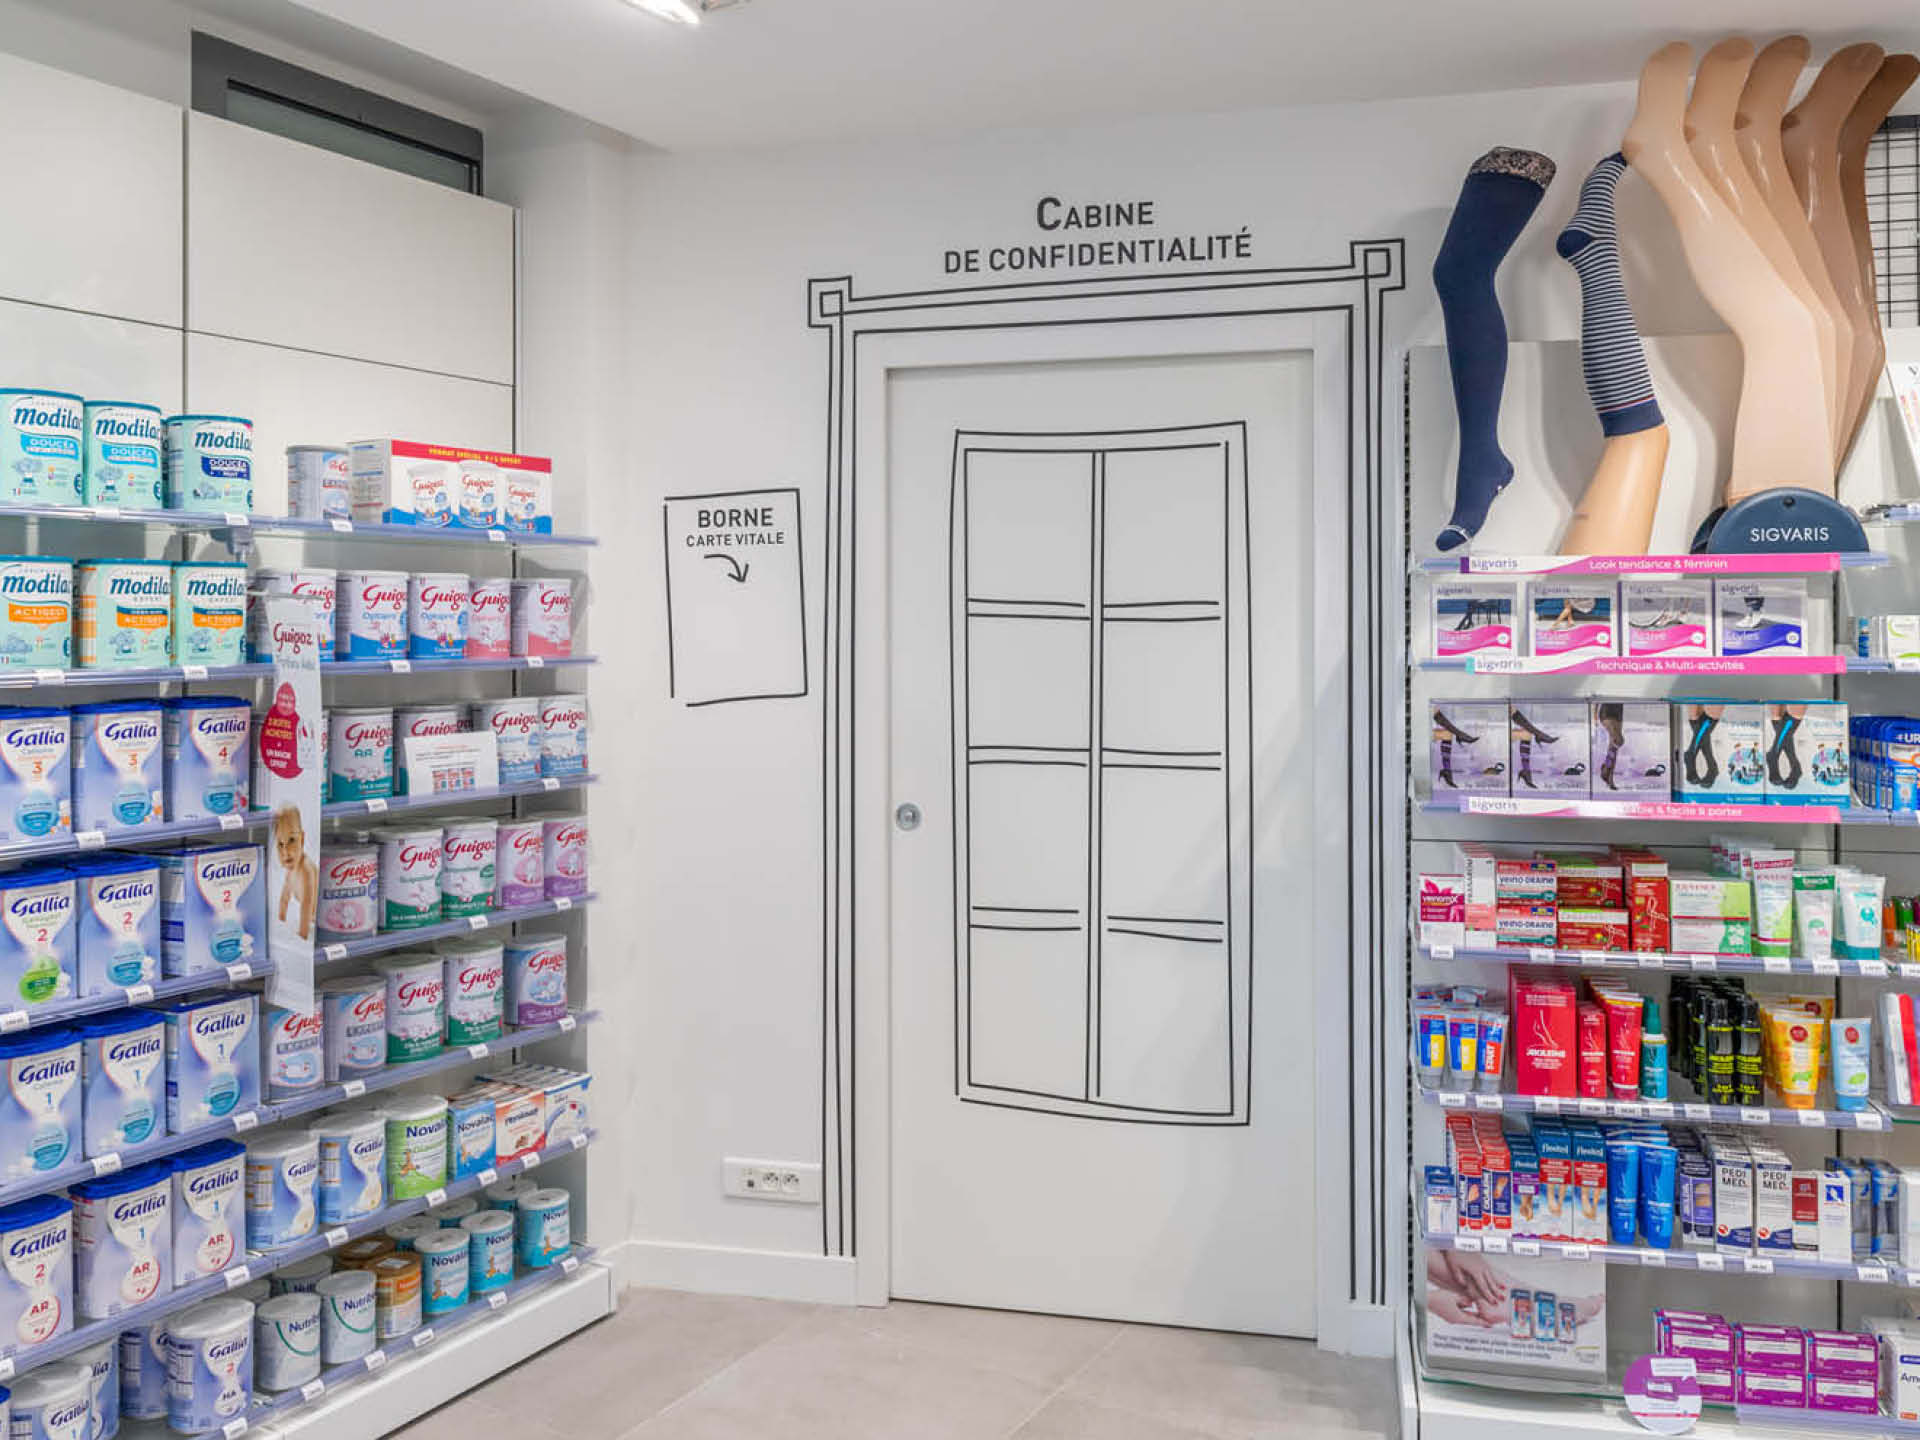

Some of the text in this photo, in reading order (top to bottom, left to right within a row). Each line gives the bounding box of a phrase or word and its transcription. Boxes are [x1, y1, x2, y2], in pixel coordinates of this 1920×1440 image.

[944, 226, 1252, 274] DE CONFIDENTIALITÉ
[194, 431, 251, 450] Modila
[697, 507, 774, 528] BORNE
[686, 531, 785, 547] CARTE VITALE
[1750, 527, 1829, 542] SIGVARIS
[420, 585, 467, 611] Guigo
[273, 622, 313, 655] Guigoz
[198, 716, 247, 734] Gallia
[491, 710, 537, 733] Guigo
[541, 707, 587, 730] Guigo
[6, 728, 66, 748] Gallia
[105, 722, 158, 741] Gallia
[128, 752, 138, 766] 3
[218, 746, 228, 761] 4
[32, 760, 43, 774] 3
[201, 860, 251, 881] Gallia
[98, 883, 154, 903] Gallia
[223, 890, 232, 903] 2
[11, 896, 70, 917] Gallia
[123, 911, 133, 925] 2
[37, 928, 48, 942] 2
[195, 1012, 245, 1036] Gallia
[109, 1037, 161, 1061] Gallia
[218, 1043, 225, 1055] 1
[18, 1058, 76, 1085] Gallia
[135, 1069, 142, 1082] 1
[46, 1093, 52, 1106] 1
[189, 1169, 239, 1194] Gallia
[114, 1193, 167, 1222] Gallia
[213, 1200, 219, 1211] 1
[139, 1227, 145, 1240] 1
[208, 1234, 225, 1247] AR
[9, 1228, 67, 1259] Gallia
[35, 1264, 45, 1278] 2
[133, 1261, 151, 1276] AR
[30, 1300, 49, 1316] AR
